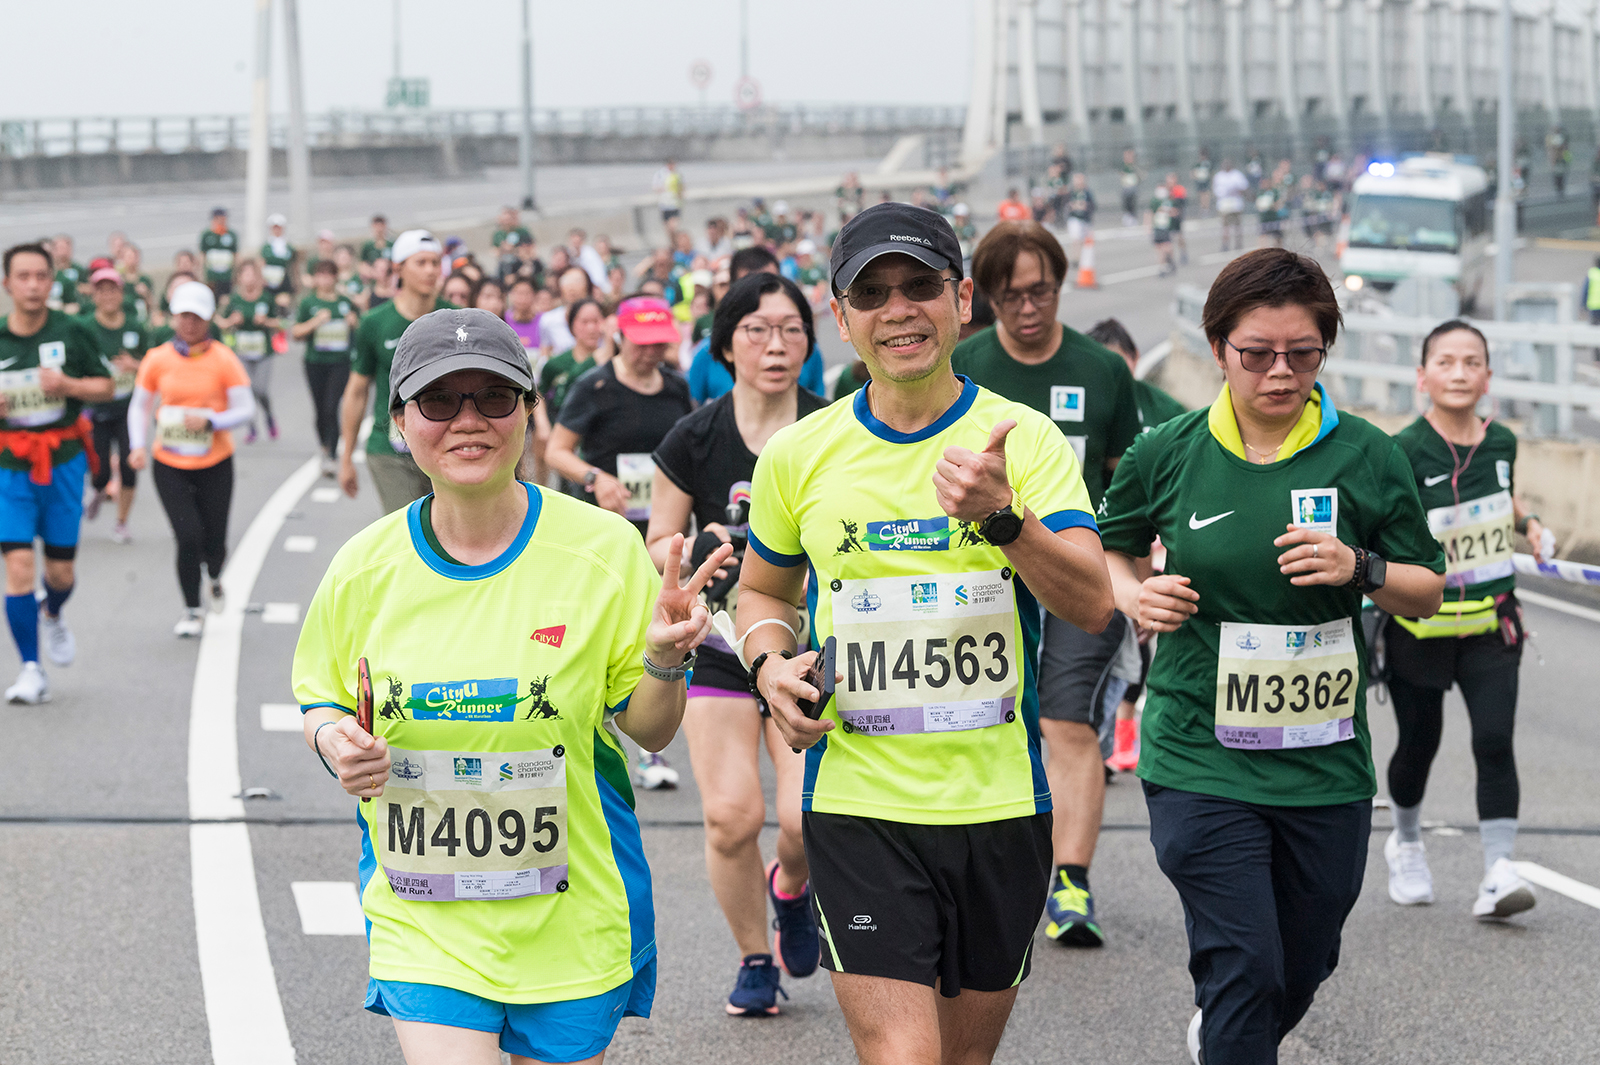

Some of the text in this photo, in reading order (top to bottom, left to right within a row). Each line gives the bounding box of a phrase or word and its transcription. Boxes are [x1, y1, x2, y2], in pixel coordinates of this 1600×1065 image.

[890, 234, 922, 244] Reebok
[879, 521, 919, 541] CityU
[889, 534, 940, 549] Runner
[972, 583, 1002, 591] standard
[972, 588, 1004, 597] chartered
[534, 632, 559, 644] CityU
[847, 632, 1009, 692] M4563
[426, 682, 478, 707] CityU
[1226, 668, 1353, 714] M3362
[437, 700, 503, 718] Runner
[518, 760, 551, 768] standard
[518, 765, 554, 773] chartered
[388, 802, 560, 858] M4095
[409, 887, 425, 895] Run
